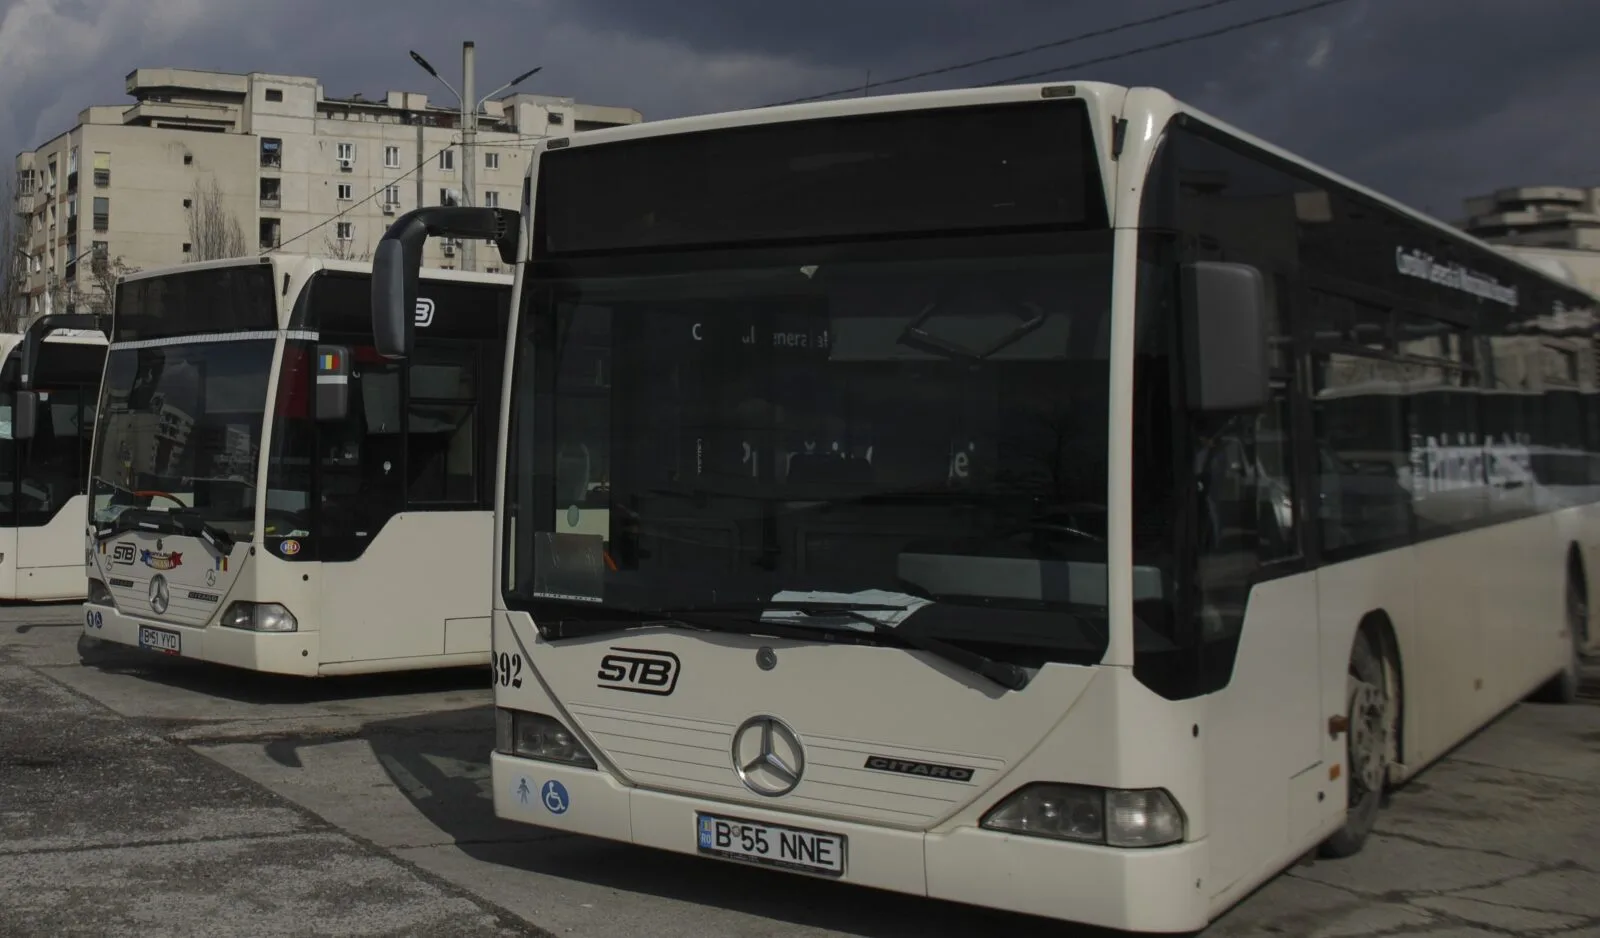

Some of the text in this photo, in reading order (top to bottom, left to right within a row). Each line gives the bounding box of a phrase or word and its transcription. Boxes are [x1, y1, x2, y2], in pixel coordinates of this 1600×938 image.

[113, 546, 134, 561] STB
[144, 629, 177, 649] B 51 YYD
[597, 654, 672, 686] STB
[870, 758, 969, 779] CITARO
[700, 832, 712, 845] RO
[715, 821, 732, 848] B
[741, 826, 769, 855] 55
[780, 831, 834, 866] NNE
